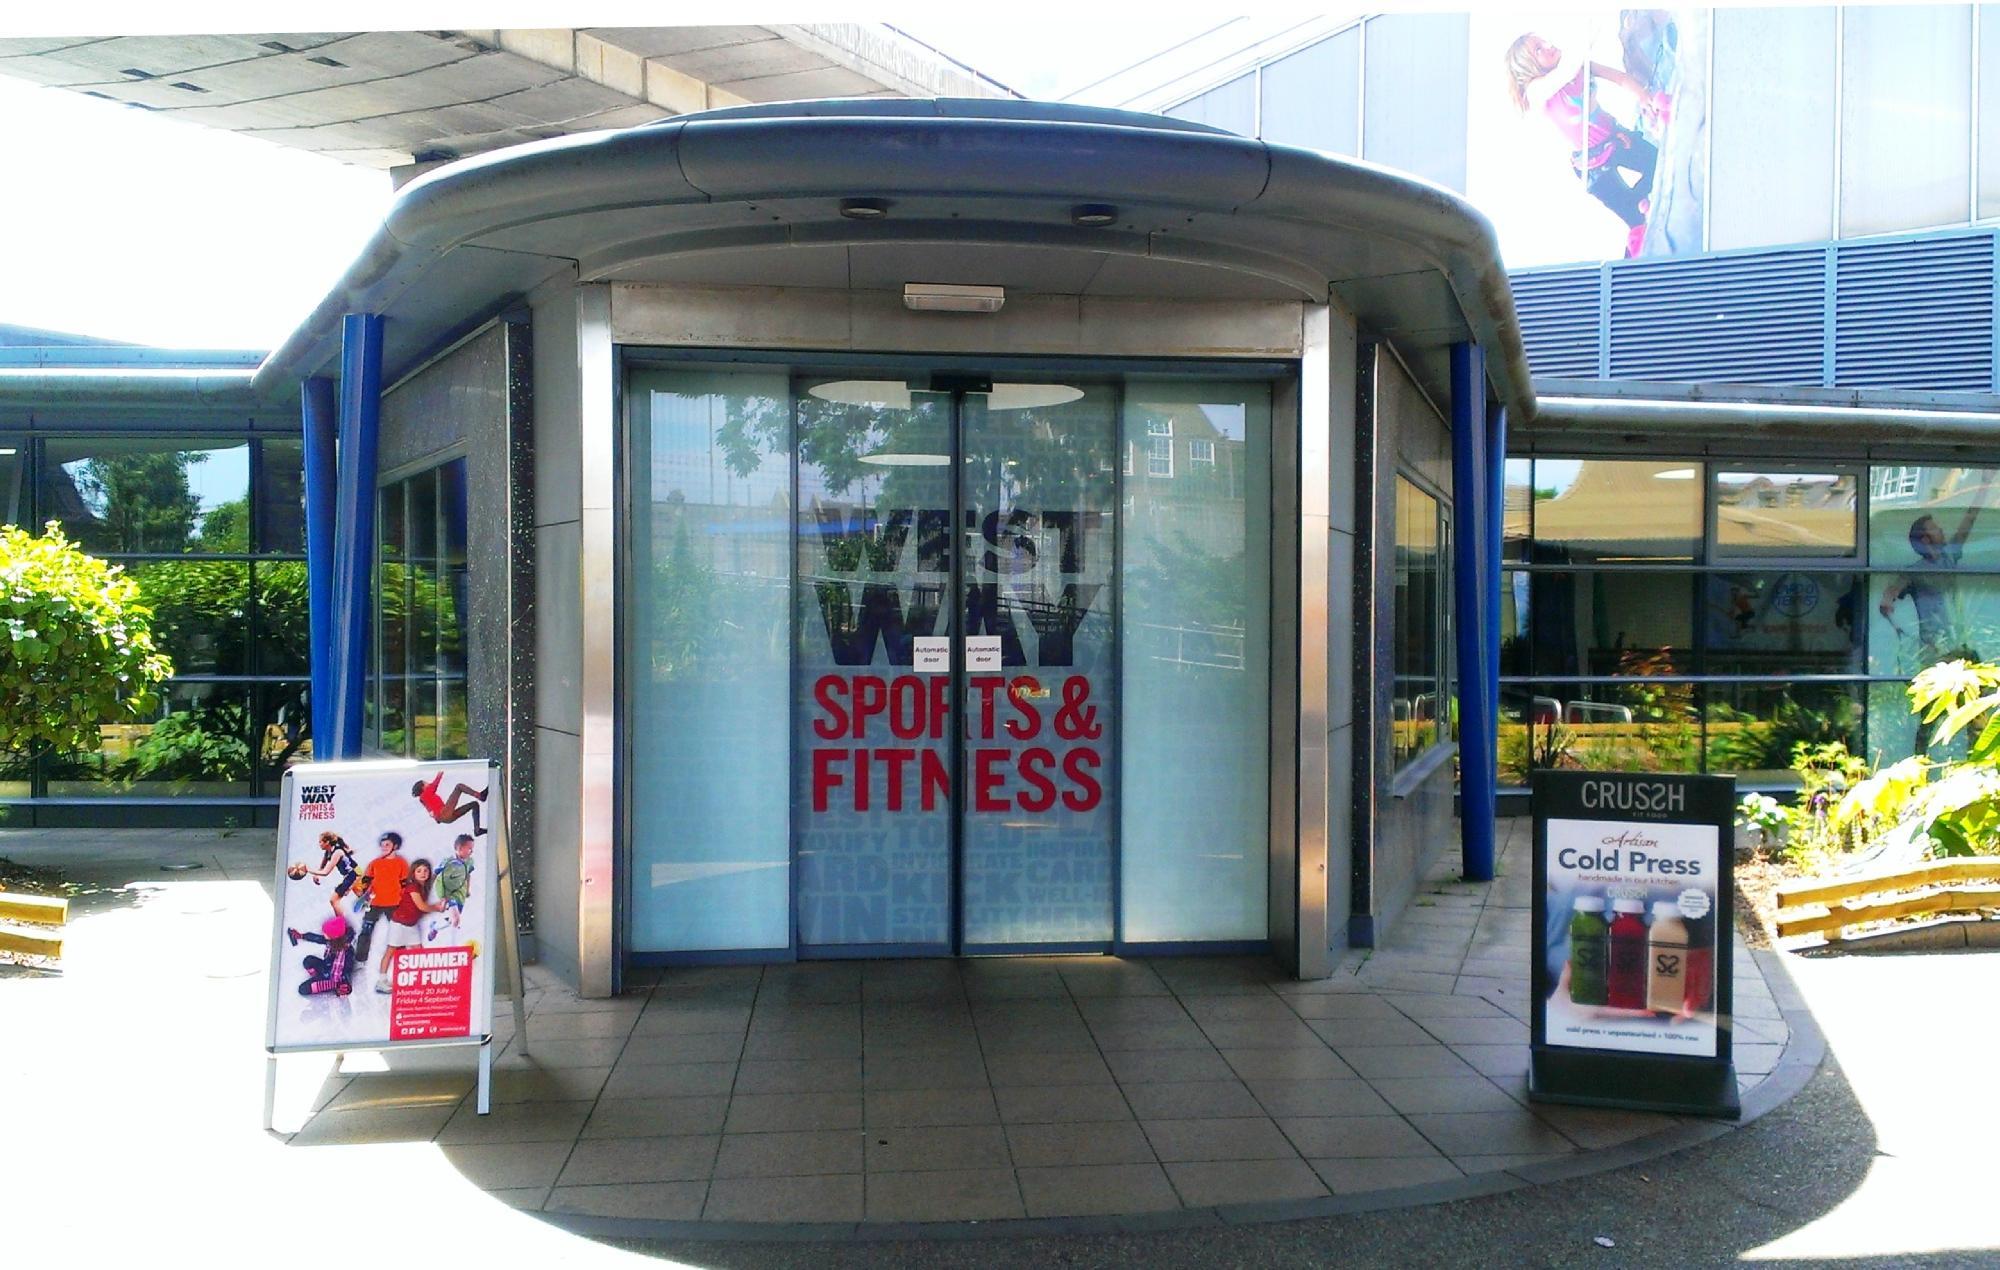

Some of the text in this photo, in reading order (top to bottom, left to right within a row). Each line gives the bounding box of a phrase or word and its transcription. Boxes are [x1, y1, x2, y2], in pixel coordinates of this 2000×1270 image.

[812, 508, 1102, 574] WEST
[813, 582, 1104, 667] WAY
[813, 675, 1102, 741] SPORTS &
[301, 784, 337, 794] WEST
[812, 747, 1102, 813] FITNESS
[301, 793, 335, 804] WAY
[1581, 780, 1685, 812] CRUSSH
[299, 811, 336, 820] FITNESS
[300, 803, 328, 813] SPORTS
[1601, 830, 1659, 848] Artisan
[1558, 848, 1702, 876] Cold Press
[1578, 873, 1623, 883] handmade
[398, 951, 469, 970] SUMMER
[397, 968, 459, 987] OF FUN!
[396, 988, 424, 996] Monday
[425, 987, 435, 995] 20
[436, 986, 450, 995] July
[396, 997, 418, 1005] Friday
[424, 995, 461, 1004] September
